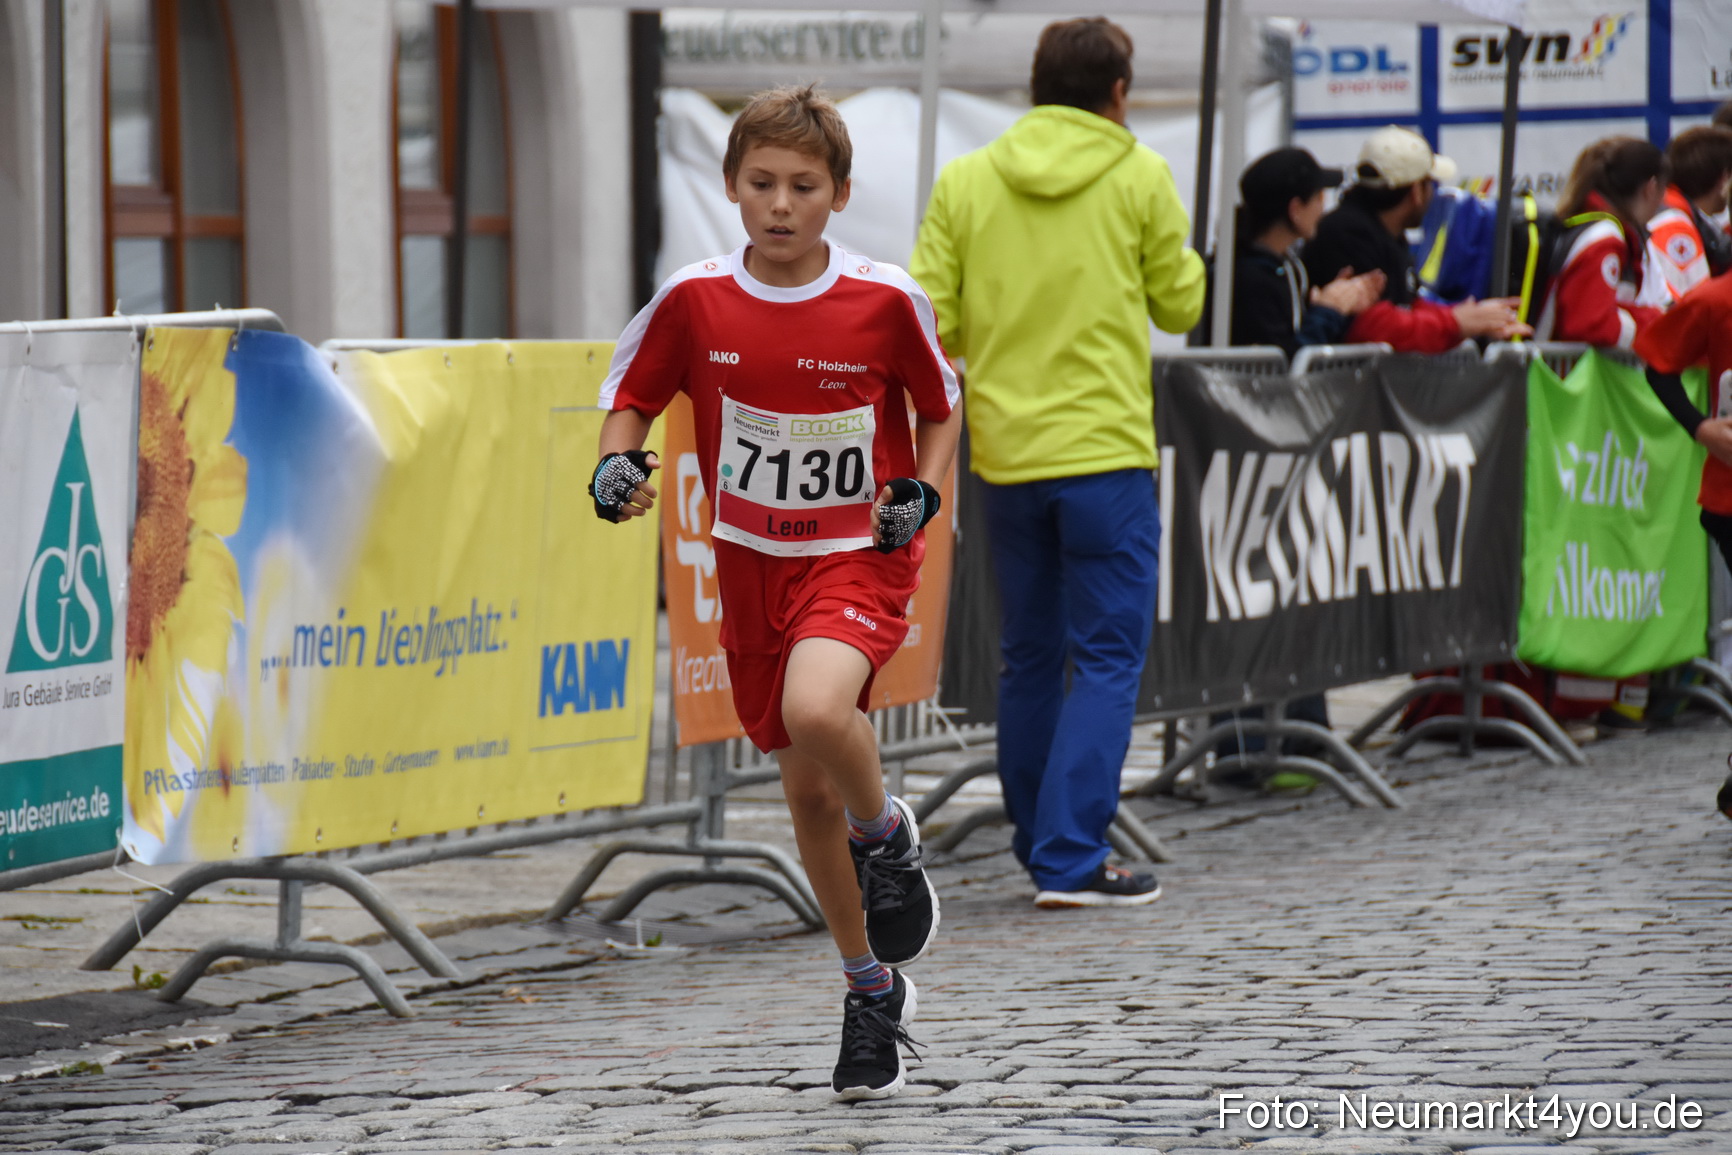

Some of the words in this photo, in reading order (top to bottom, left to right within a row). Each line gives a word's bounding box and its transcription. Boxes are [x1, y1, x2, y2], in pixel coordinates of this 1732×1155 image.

[709, 350, 740, 365] JAKO
[797, 358, 815, 370] FC
[818, 360, 868, 373] Holzheim
[818, 378, 847, 390] Leon
[733, 416, 780, 437] NeuerMarkt
[790, 413, 866, 436] BOCK
[737, 437, 865, 501] 7130
[723, 481, 729, 490] 6
[864, 491, 871, 500] K
[767, 514, 818, 536] Leon
[856, 613, 876, 631] JAKO
[538, 638, 630, 718] KANN
[2, 685, 20, 709] Jura
[64, 677, 91, 701] Service
